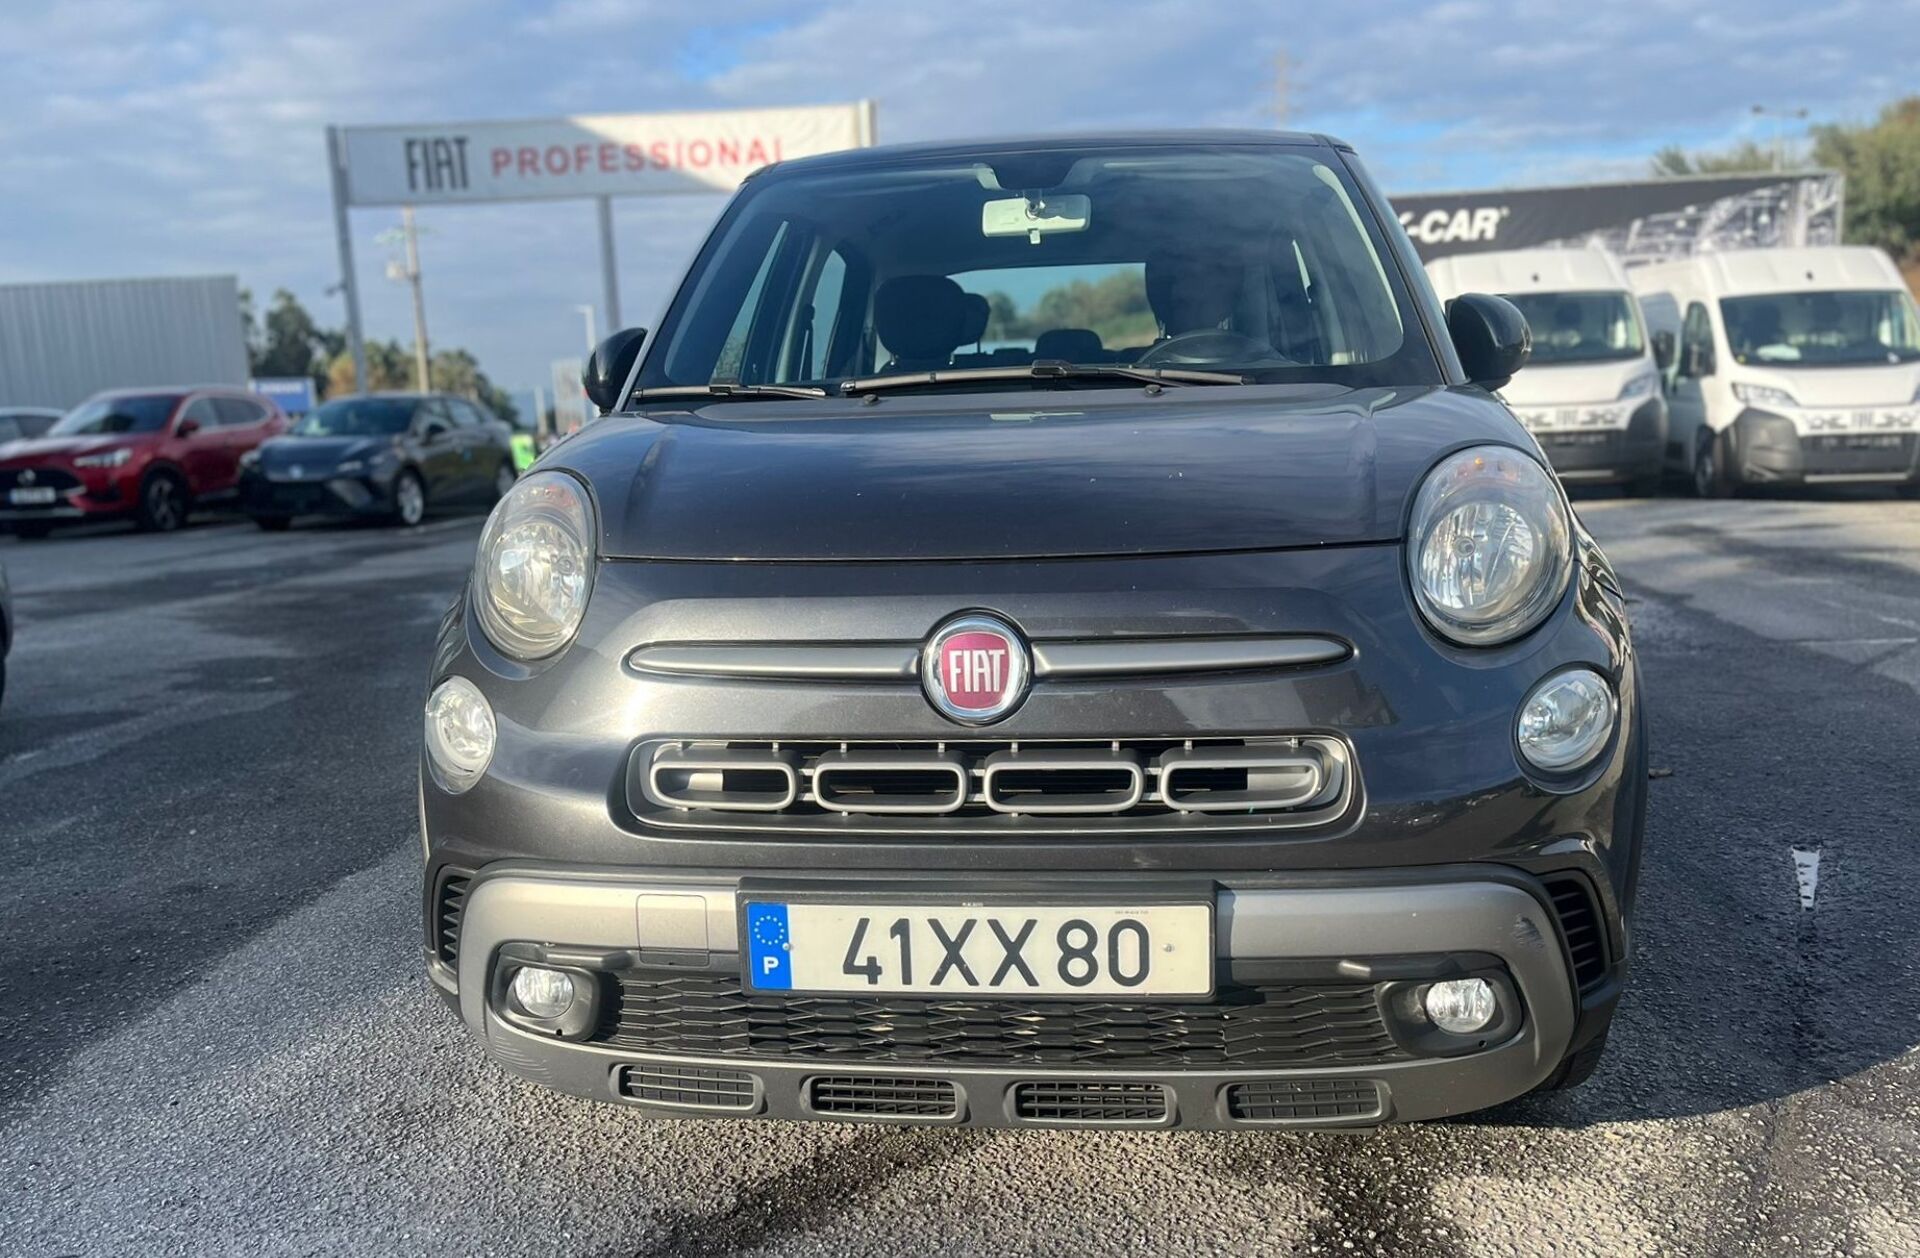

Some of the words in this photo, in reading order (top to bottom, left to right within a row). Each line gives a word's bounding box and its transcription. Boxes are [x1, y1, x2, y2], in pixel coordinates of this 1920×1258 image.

[404, 136, 469, 192] FIAT
[948, 649, 1005, 693] FIAT
[762, 955, 779, 975] P
